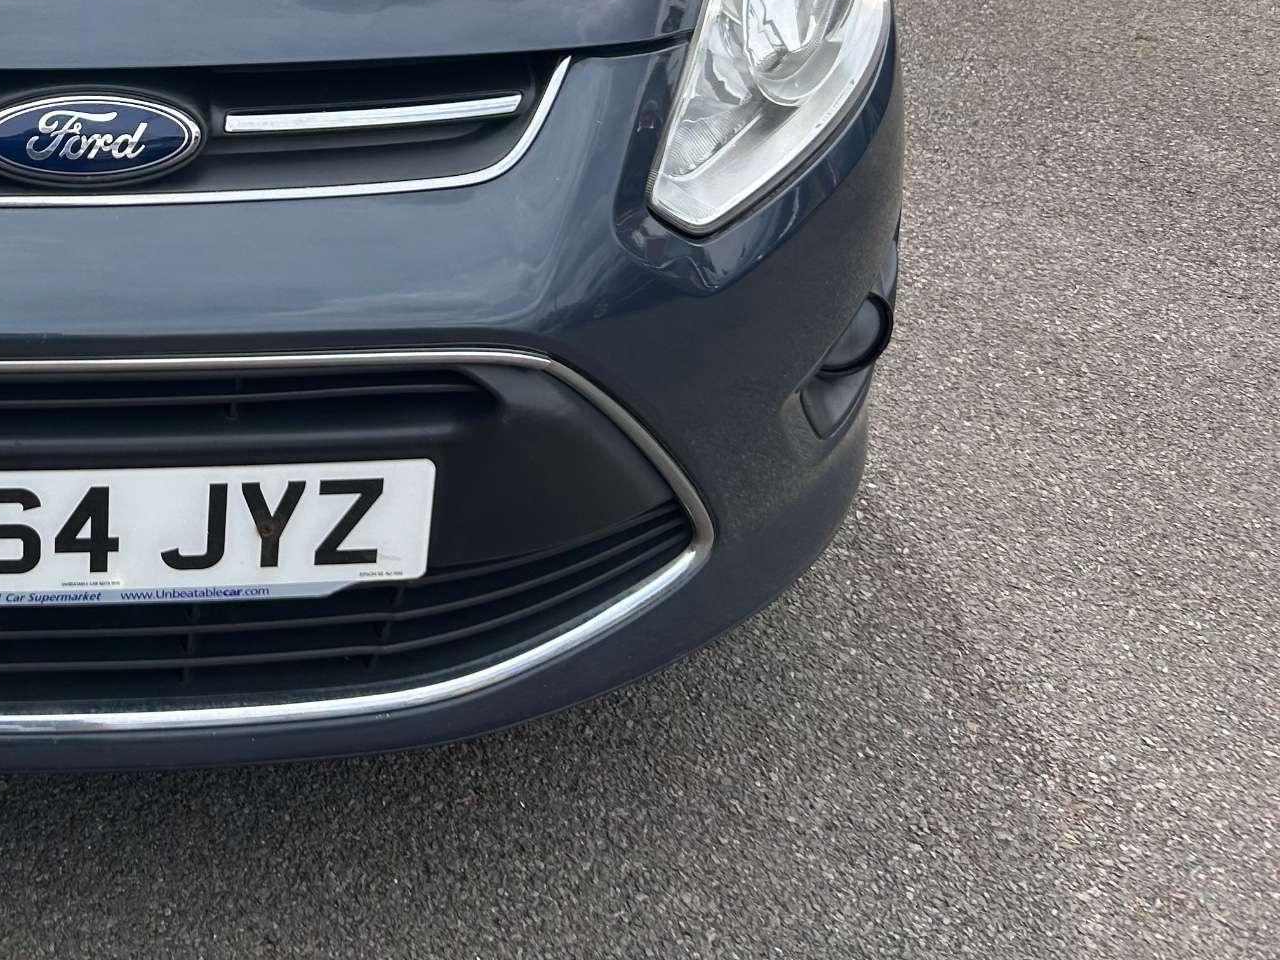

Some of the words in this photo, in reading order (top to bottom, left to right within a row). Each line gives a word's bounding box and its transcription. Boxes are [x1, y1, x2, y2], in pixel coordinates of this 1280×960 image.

[26, 110, 148, 161] Ford
[160, 477, 384, 570] JYZ
[5, 592, 25, 602] Car
[28, 591, 102, 605] Supermarket
[121, 586, 270, 600] www.Unbeatablecar.com
